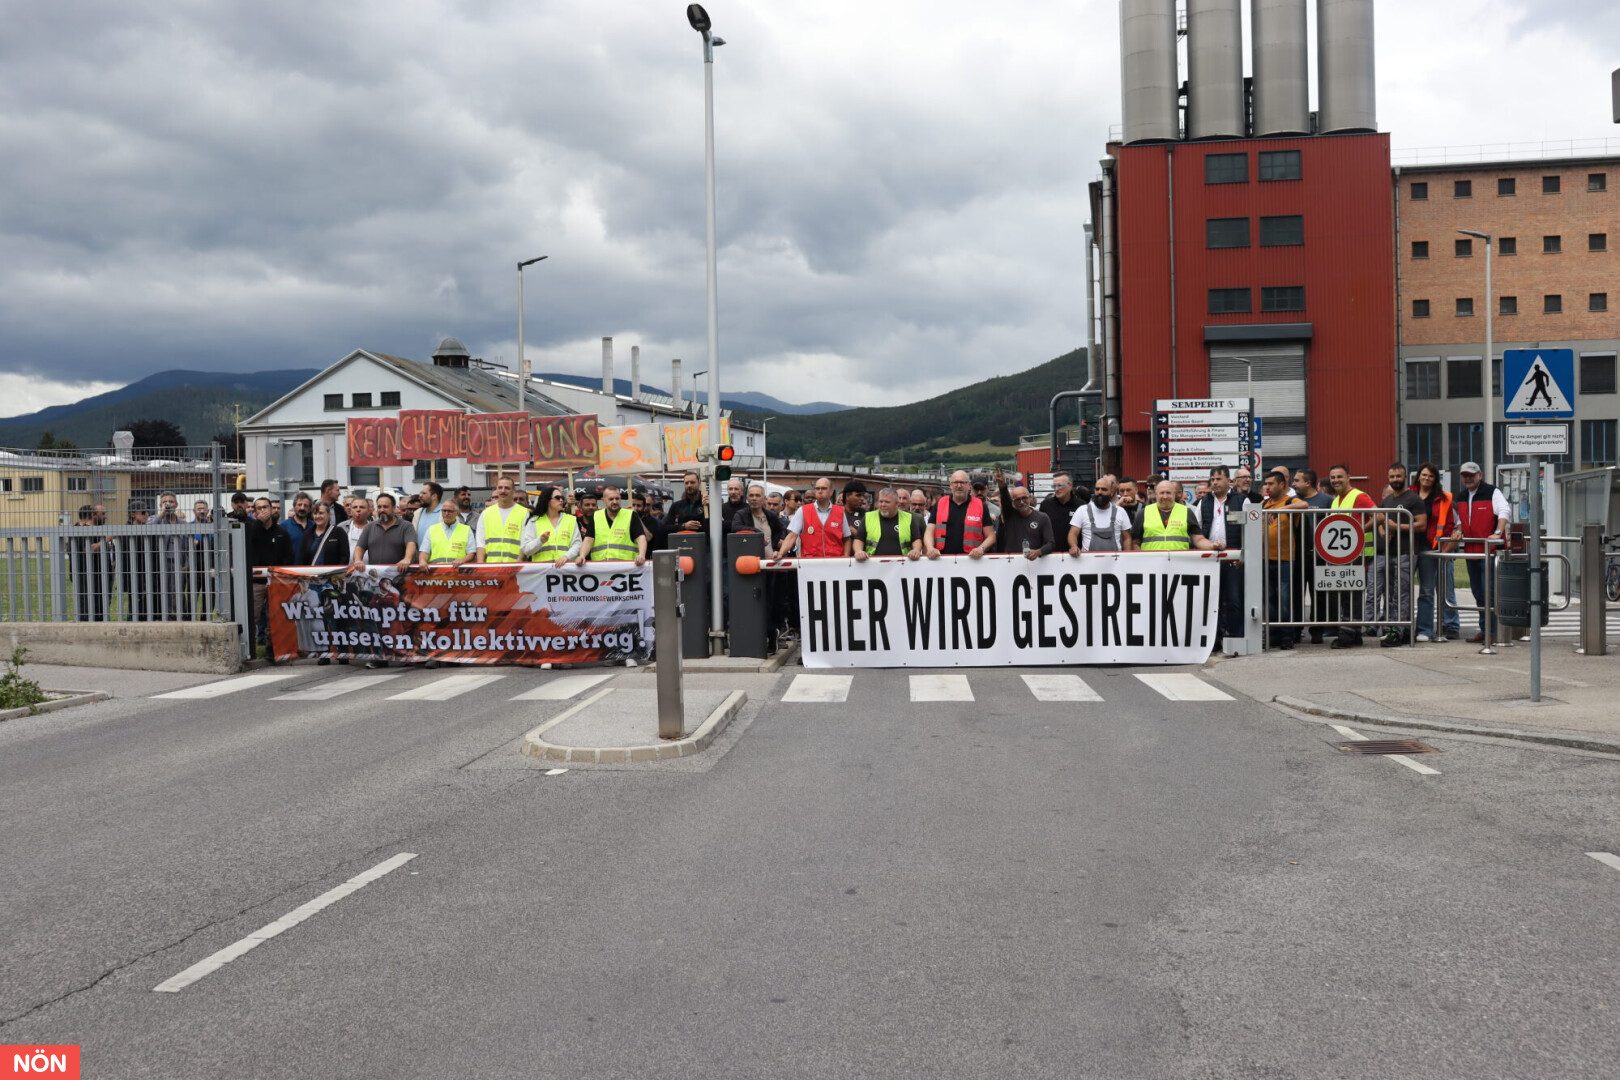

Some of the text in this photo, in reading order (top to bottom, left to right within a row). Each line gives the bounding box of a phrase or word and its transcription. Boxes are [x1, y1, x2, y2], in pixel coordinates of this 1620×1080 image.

[349, 422, 399, 460] KEIN
[400, 414, 467, 455] CHEMIE
[467, 417, 529, 457] OHNE
[534, 418, 598, 459] UNS
[1327, 528, 1352, 550] 25
[414, 578, 499, 588] www.proge.at
[1336, 580, 1363, 588] StVO
[1340, 569, 1356, 578] gilt
[282, 599, 488, 628] Wir kämpfen für
[806, 572, 1211, 652] HIER WIRD GESTREIKT!
[312, 609, 646, 654] unseren Kollektivvertrag!
